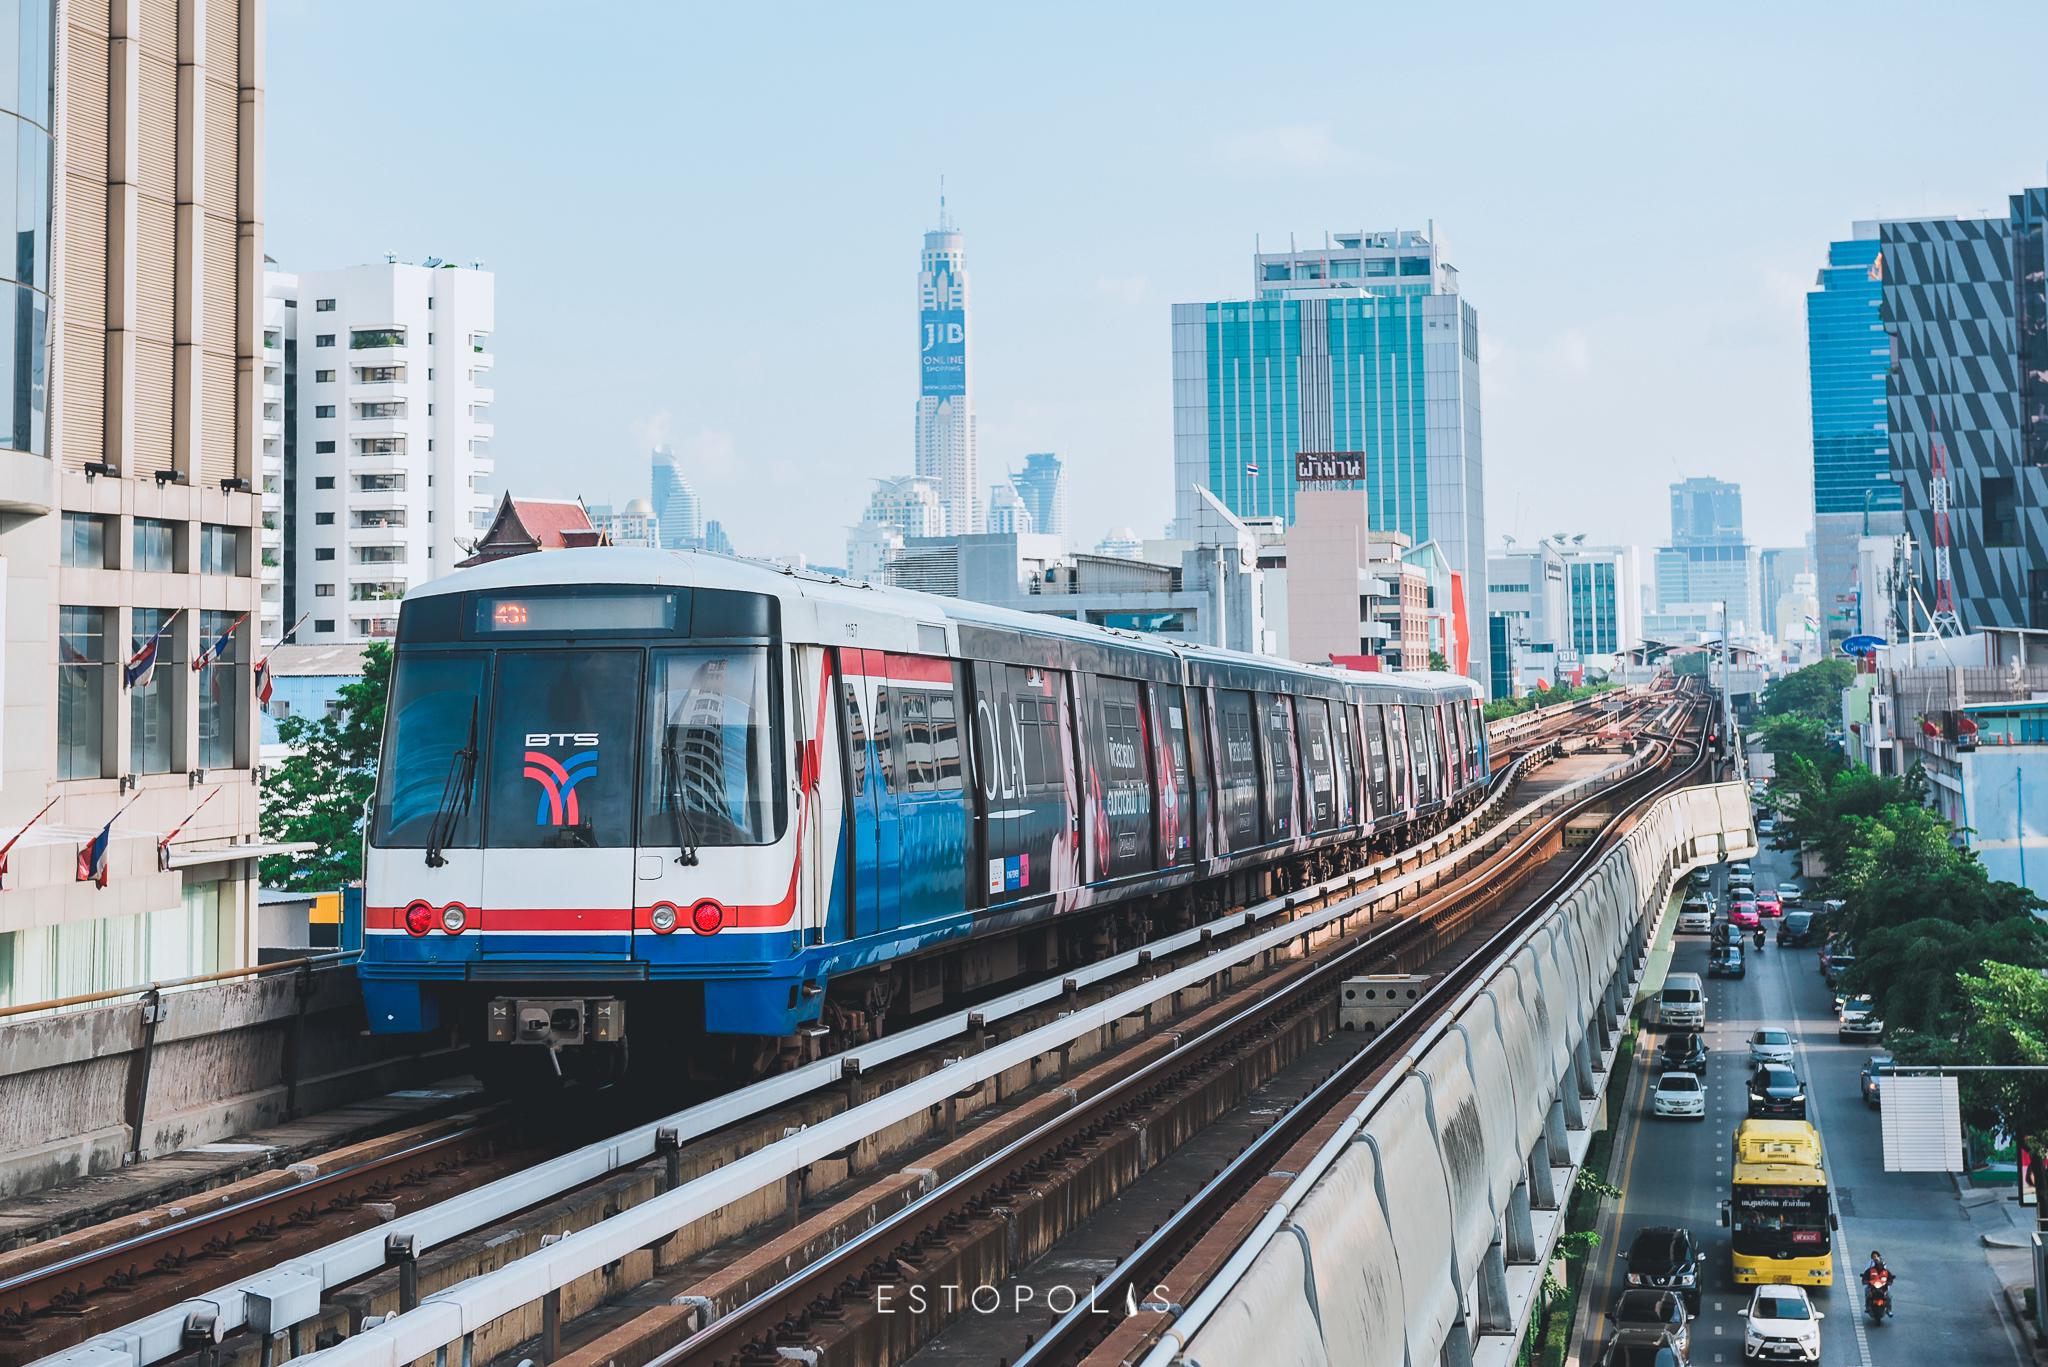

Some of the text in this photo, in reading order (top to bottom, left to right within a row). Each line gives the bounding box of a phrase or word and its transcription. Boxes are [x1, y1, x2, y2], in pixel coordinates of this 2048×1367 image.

[922, 322, 964, 351] JIB
[923, 355, 964, 365] ONLINE
[1299, 455, 1361, 477] ผ้าม่าน
[525, 733, 599, 747] BTS
